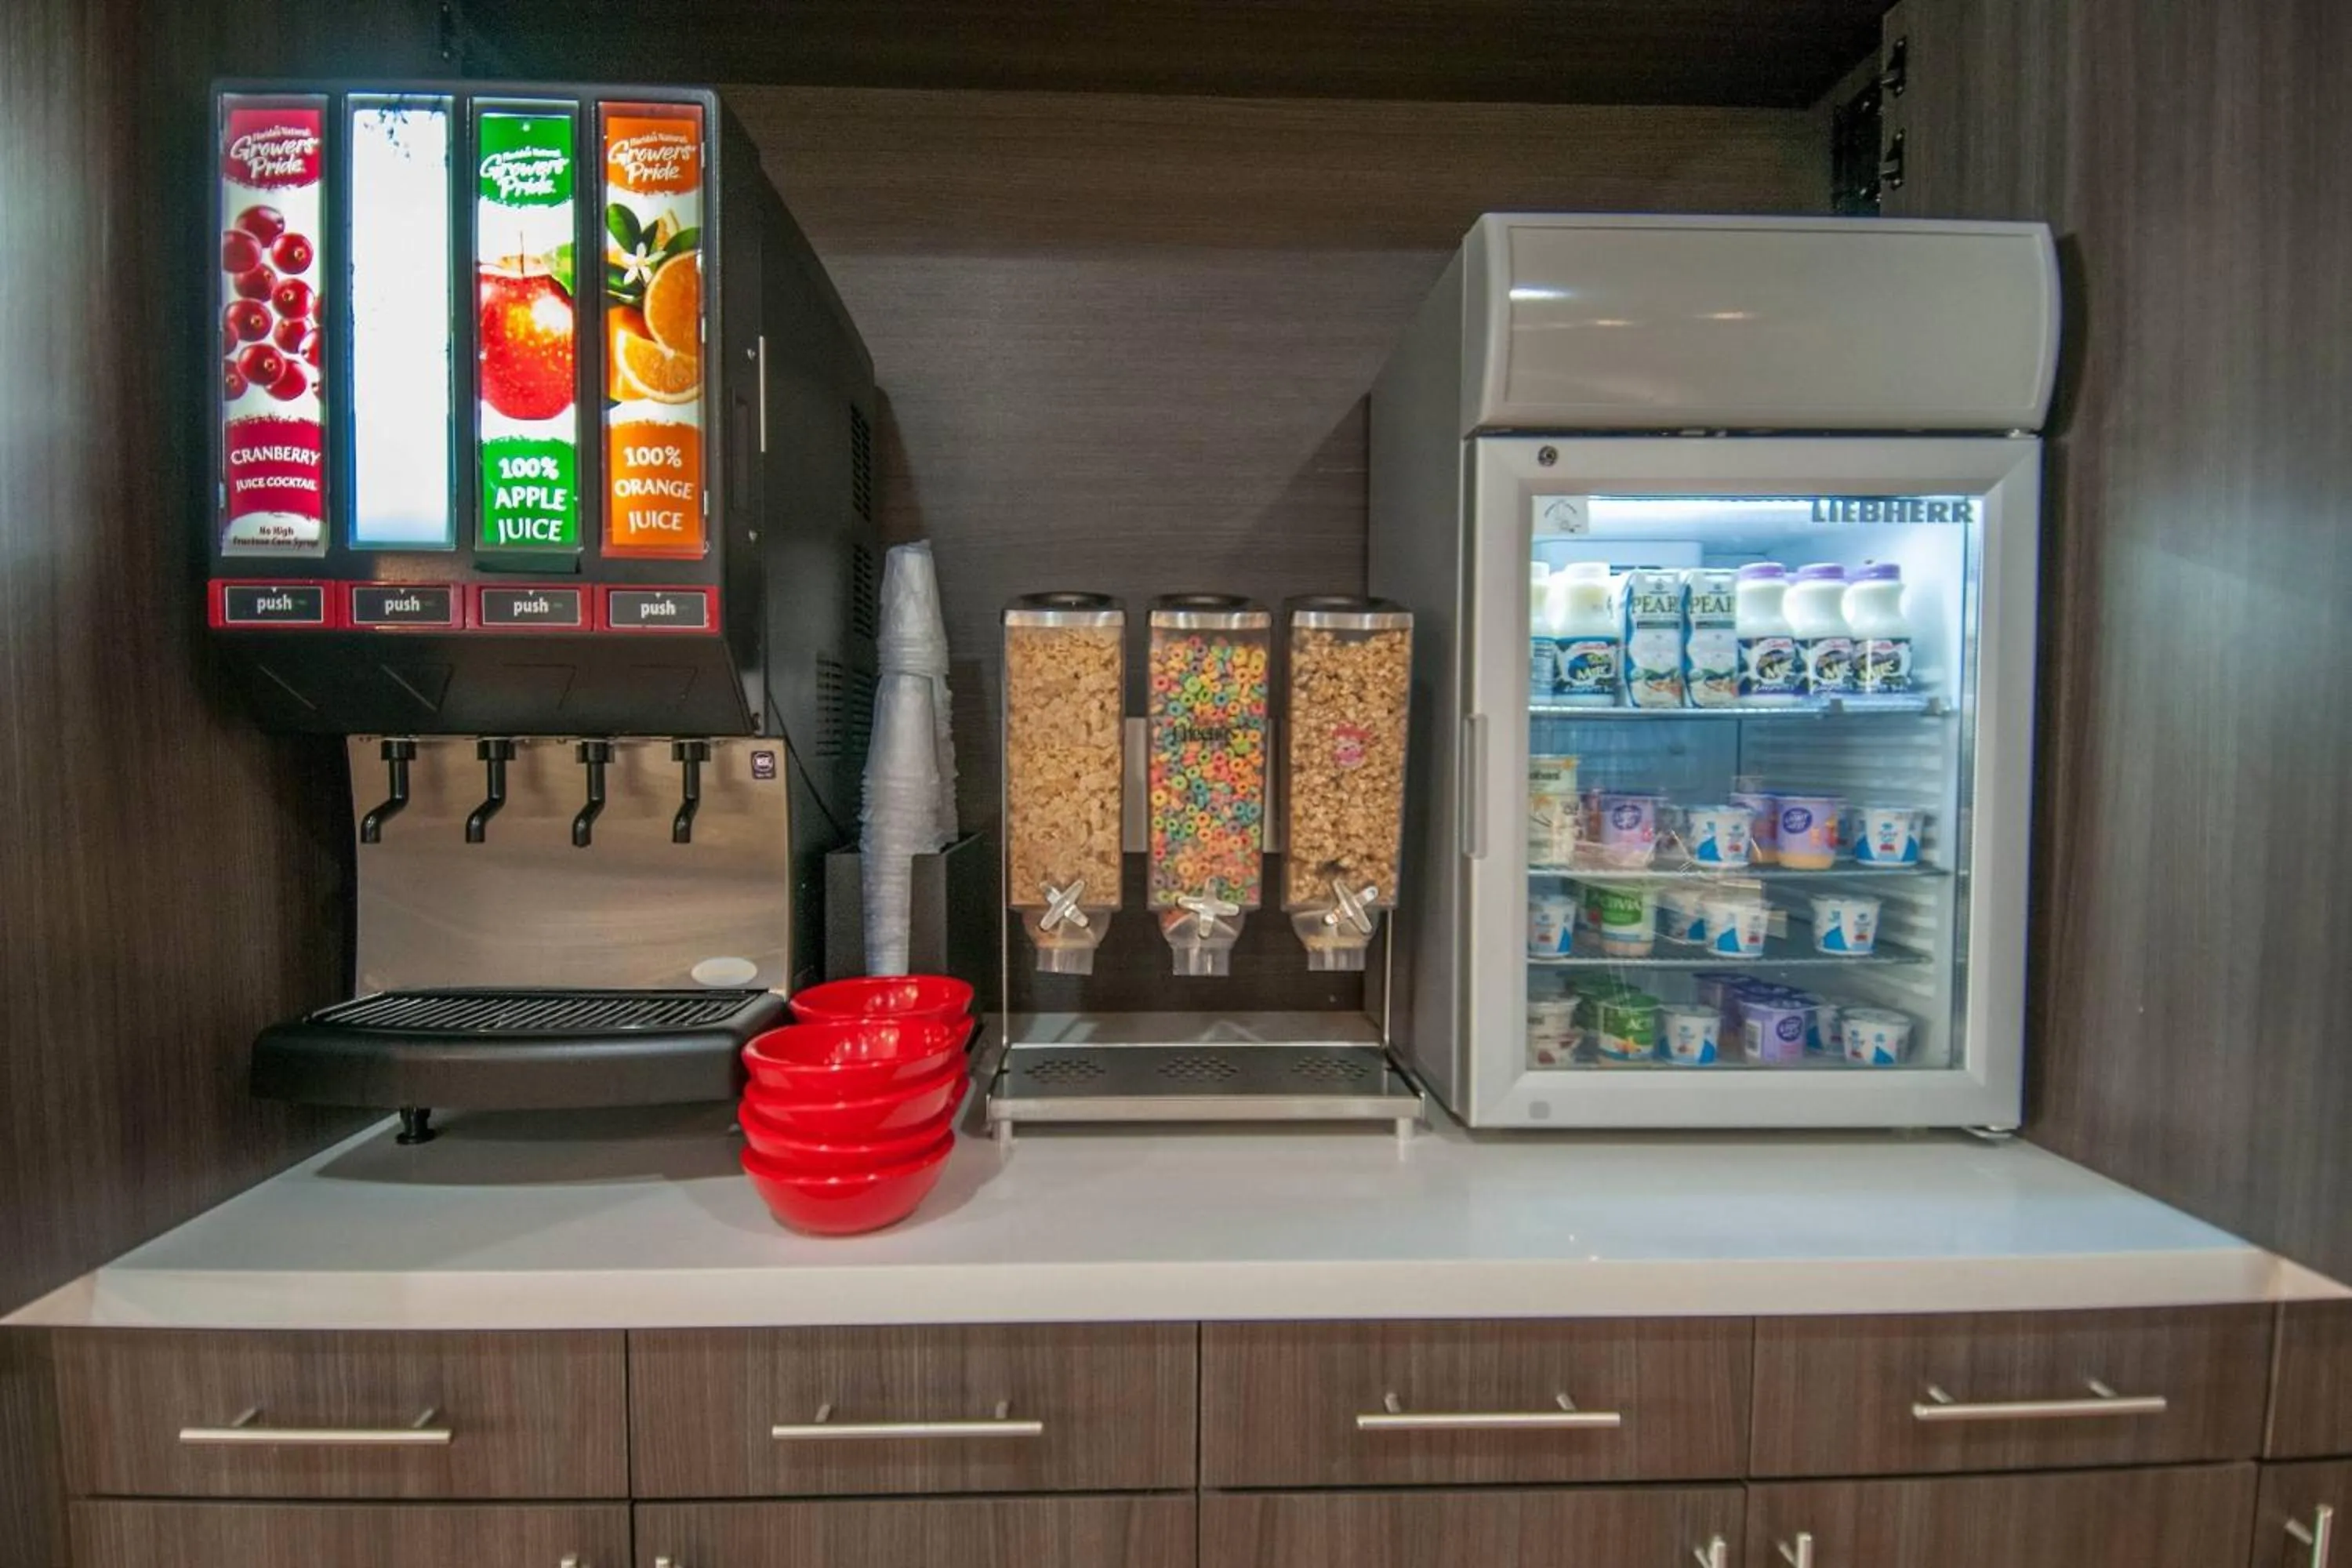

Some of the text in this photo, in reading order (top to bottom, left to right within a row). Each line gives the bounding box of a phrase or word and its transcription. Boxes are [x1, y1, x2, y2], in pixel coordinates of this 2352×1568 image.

[248, 154, 306, 178] Pride
[625, 160, 682, 184] Pride
[497, 174, 556, 198] Pride
[230, 445, 321, 466] CRANBERRY
[623, 445, 682, 468] 100%
[498, 456, 559, 480] 100%
[236, 477, 318, 493] JUICE COCKTAIL
[615, 478, 694, 500] ORANGE
[495, 486, 568, 511] APPLE
[629, 510, 684, 535] JUICE
[1812, 500, 1973, 523] LIEBHERR
[498, 517, 563, 544] JUICE
[256, 594, 292, 613] push
[384, 596, 419, 615] push
[514, 597, 549, 616] push
[641, 600, 675, 618] push
